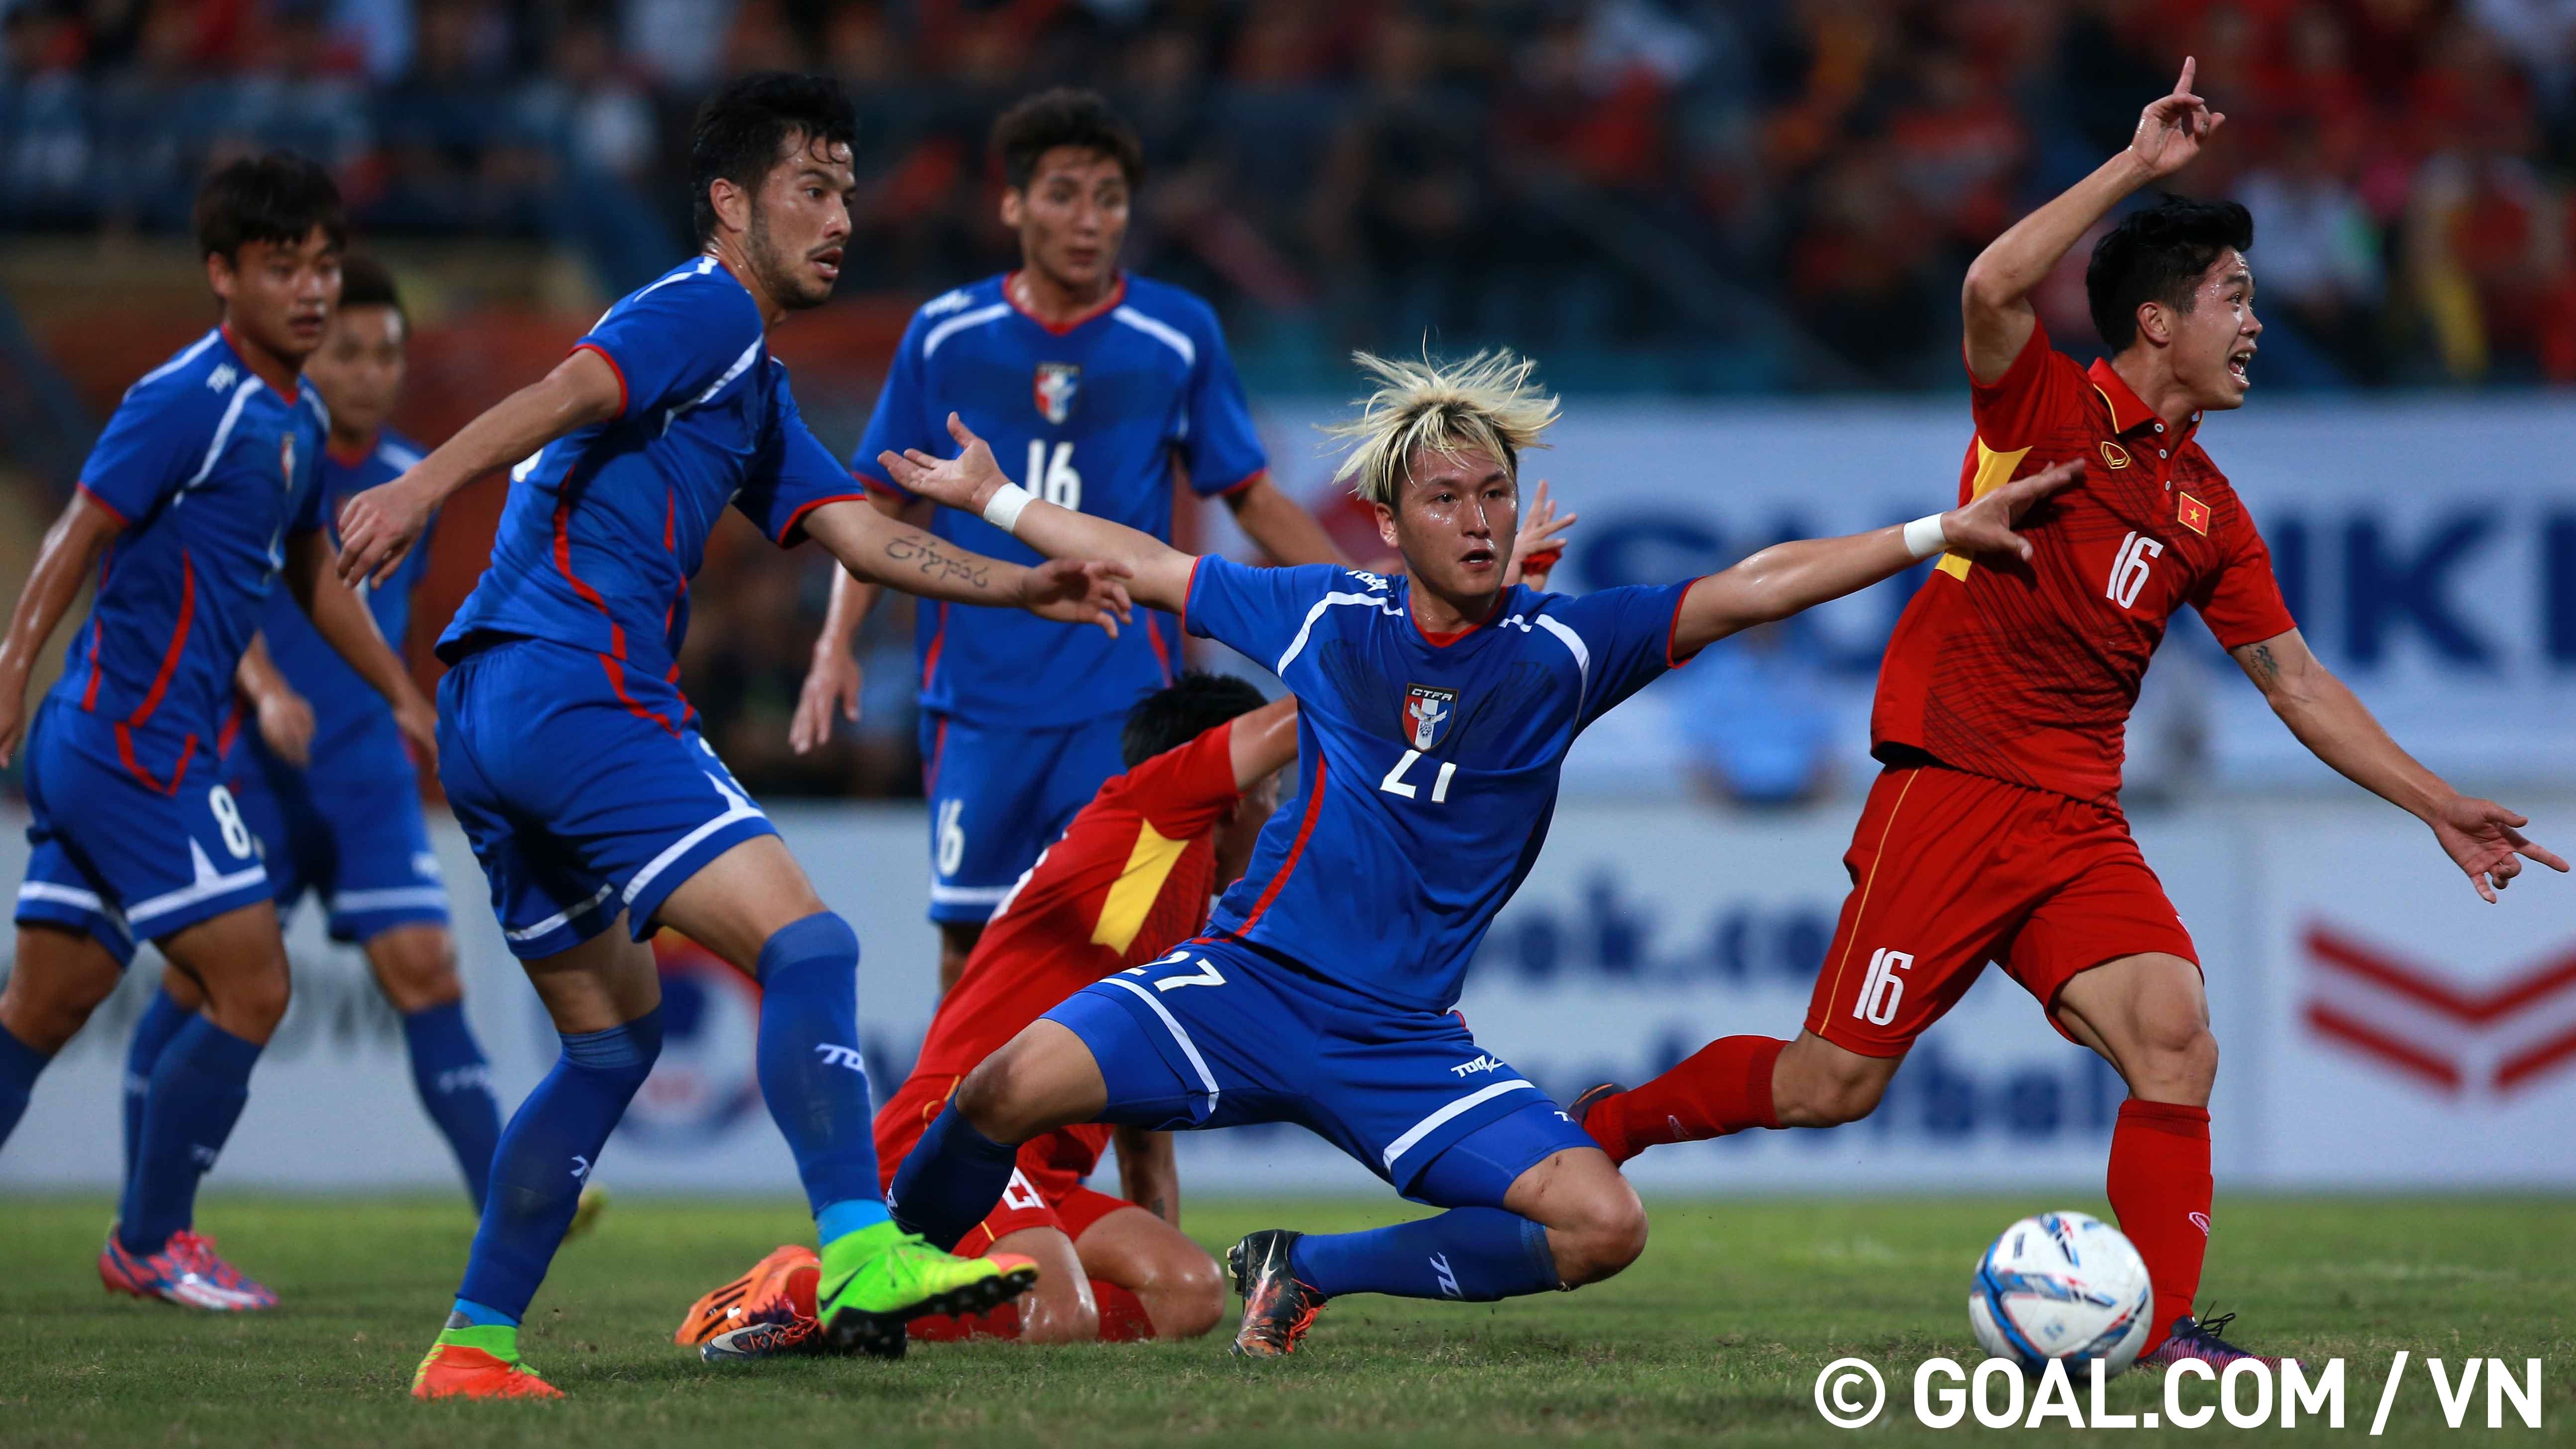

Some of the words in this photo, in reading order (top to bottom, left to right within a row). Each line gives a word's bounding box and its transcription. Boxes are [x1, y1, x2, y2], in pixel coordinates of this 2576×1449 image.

[1026, 438, 1082, 511] 16
[2106, 531, 2164, 609] 16
[1411, 688, 1453, 702] CTFA
[935, 799, 966, 877] 16
[1121, 951, 1228, 992] 27
[1853, 947, 1914, 1026] 16
[815, 1043, 865, 1073] TO
[1554, 1111, 1576, 1123] T
